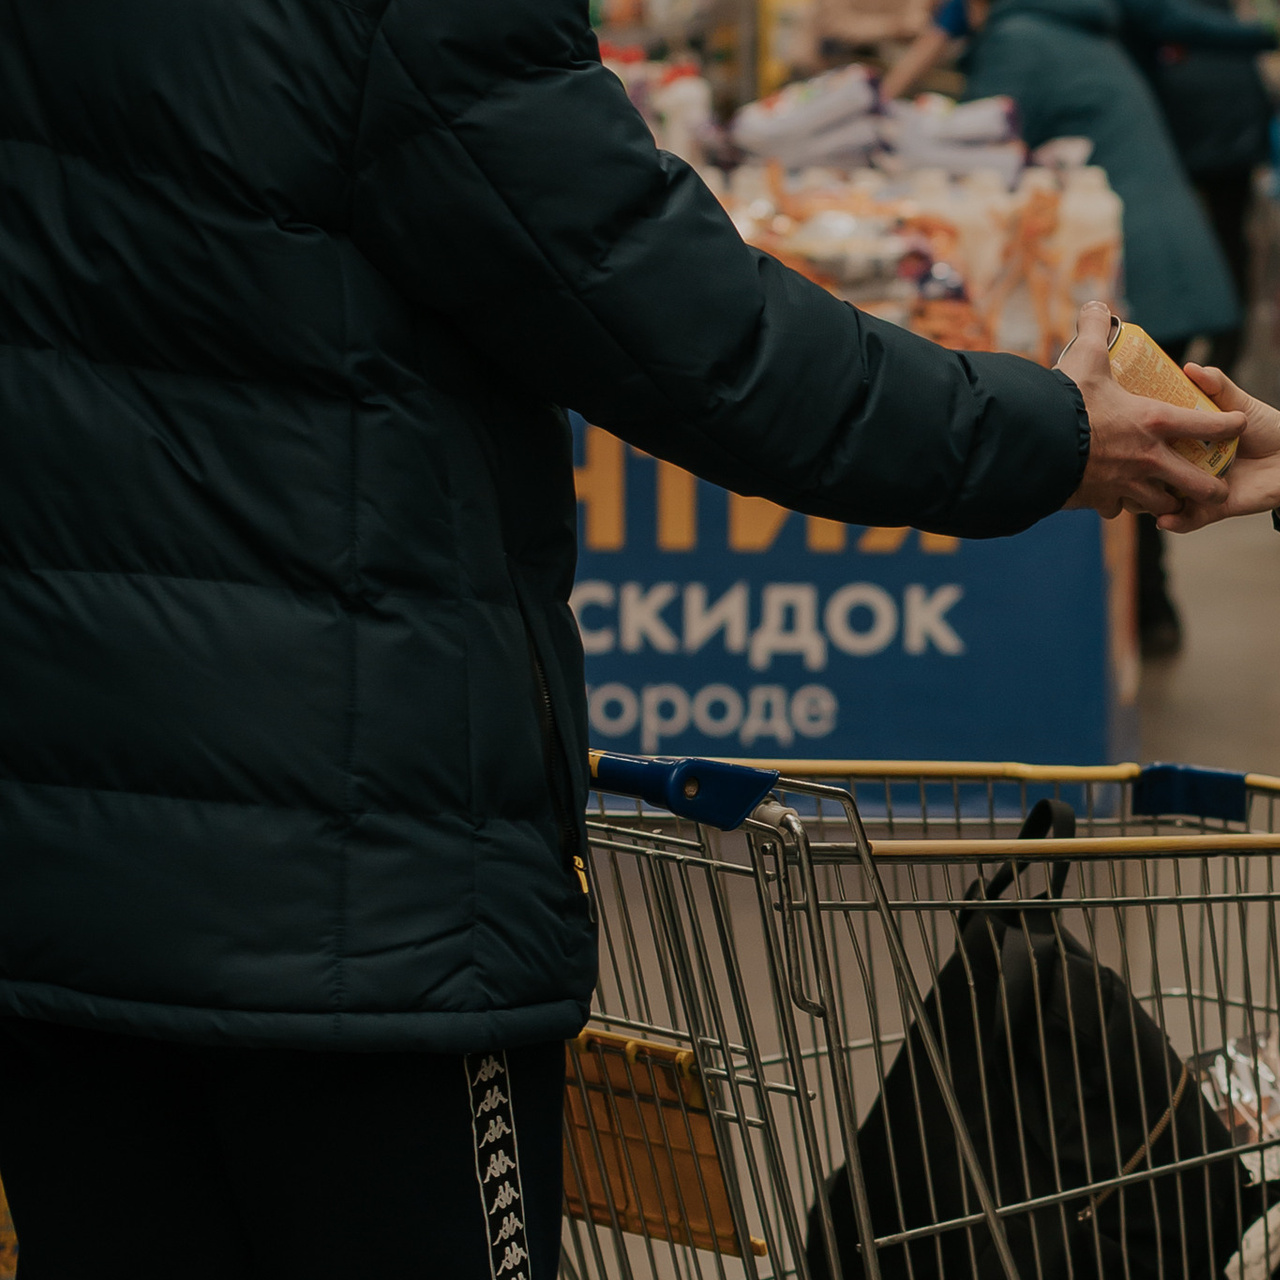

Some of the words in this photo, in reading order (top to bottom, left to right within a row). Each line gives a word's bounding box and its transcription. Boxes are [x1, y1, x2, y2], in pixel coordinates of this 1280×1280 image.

[574, 423, 960, 553] НТ
[569, 580, 966, 671] СКИДОК
[588, 683, 838, 754] ороде
